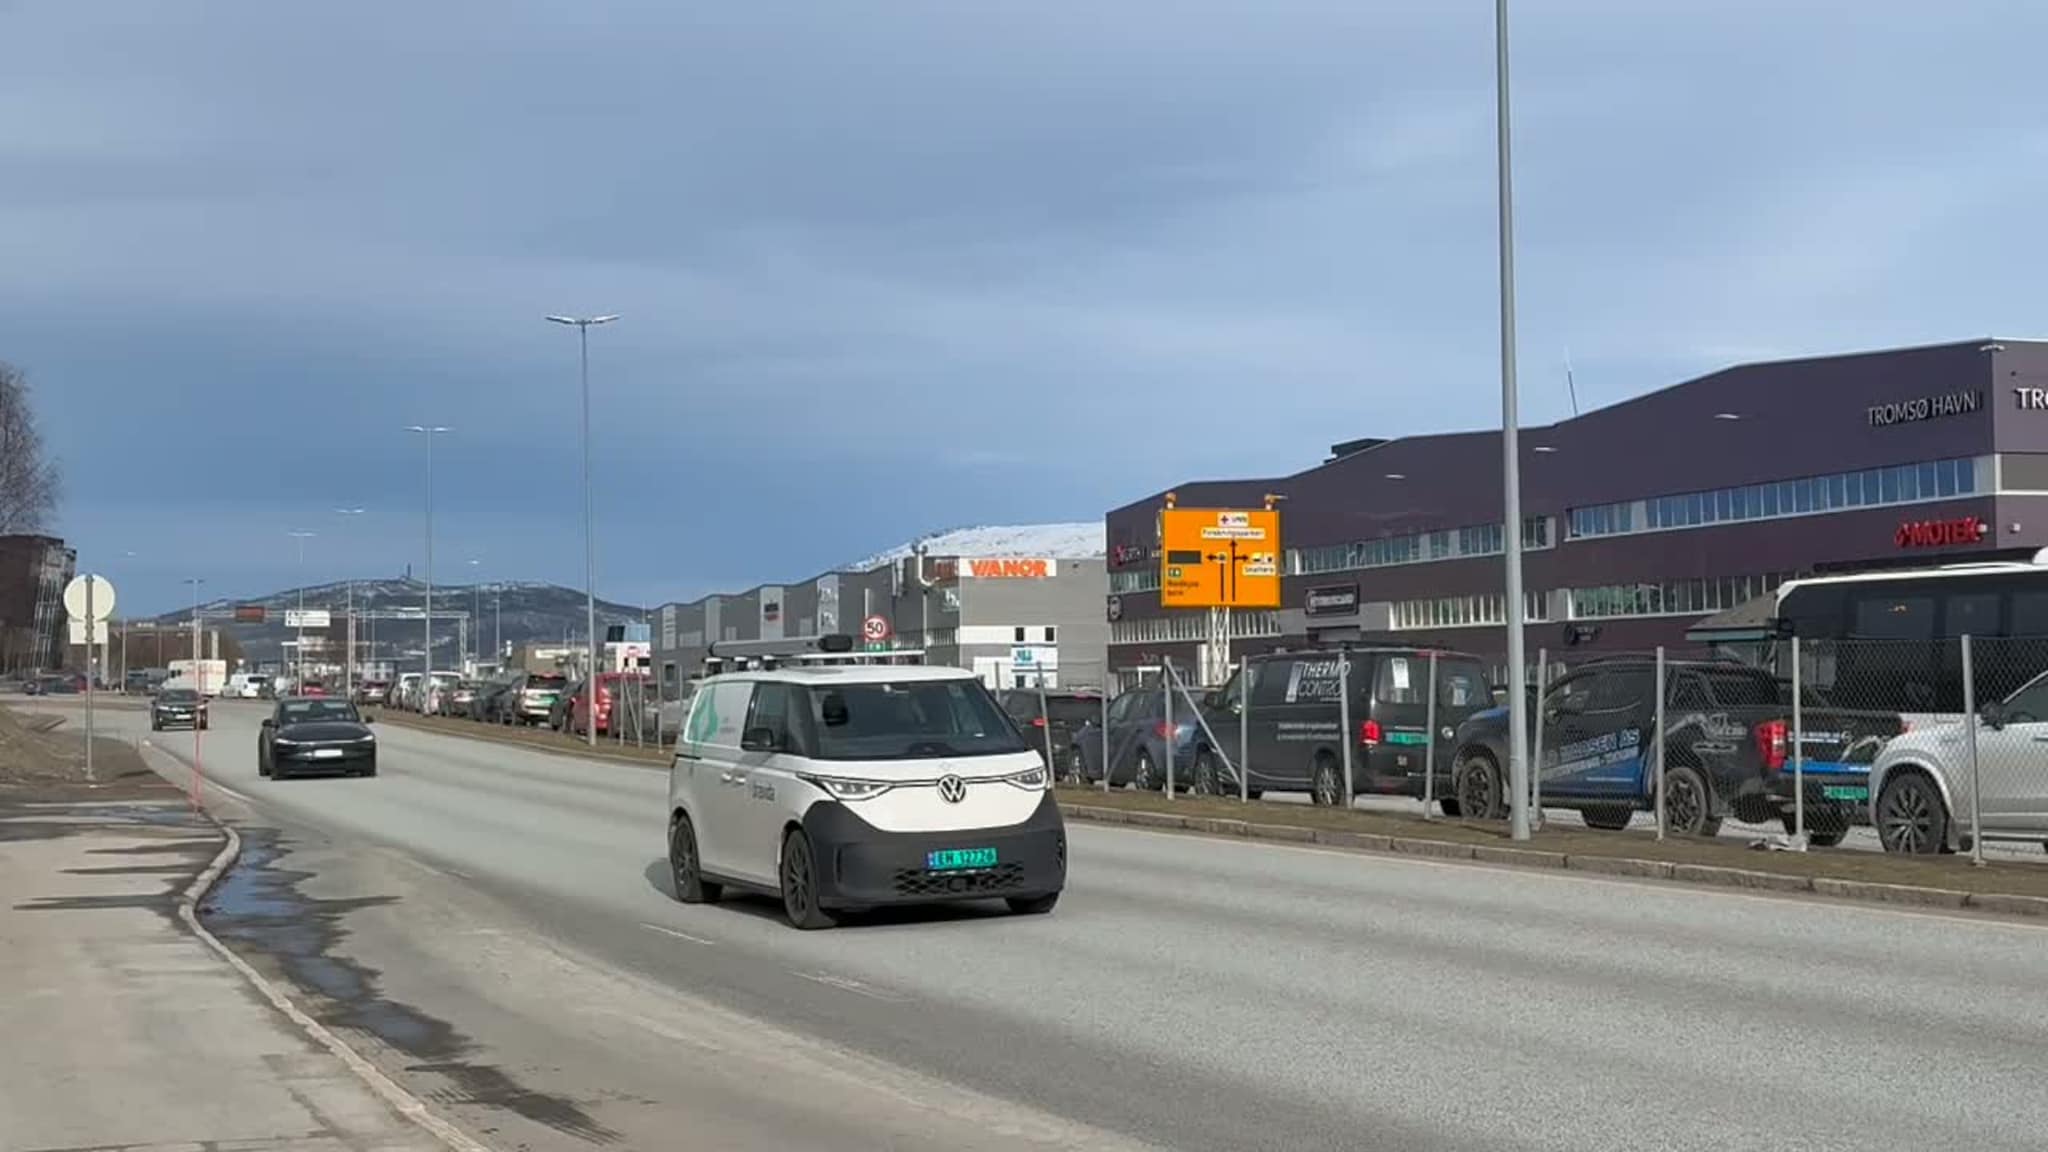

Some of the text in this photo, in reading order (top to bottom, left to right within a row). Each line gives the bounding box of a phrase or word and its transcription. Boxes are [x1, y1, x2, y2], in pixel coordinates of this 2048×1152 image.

[1867, 390, 1976, 425] TROMSØ HAVN
[2016, 388, 2048, 409] TR
[1909, 517, 1981, 546] MOTEK
[970, 559, 1047, 577] VANOR
[867, 621, 884, 635] 50
[1298, 679, 1345, 697] CONTRO
